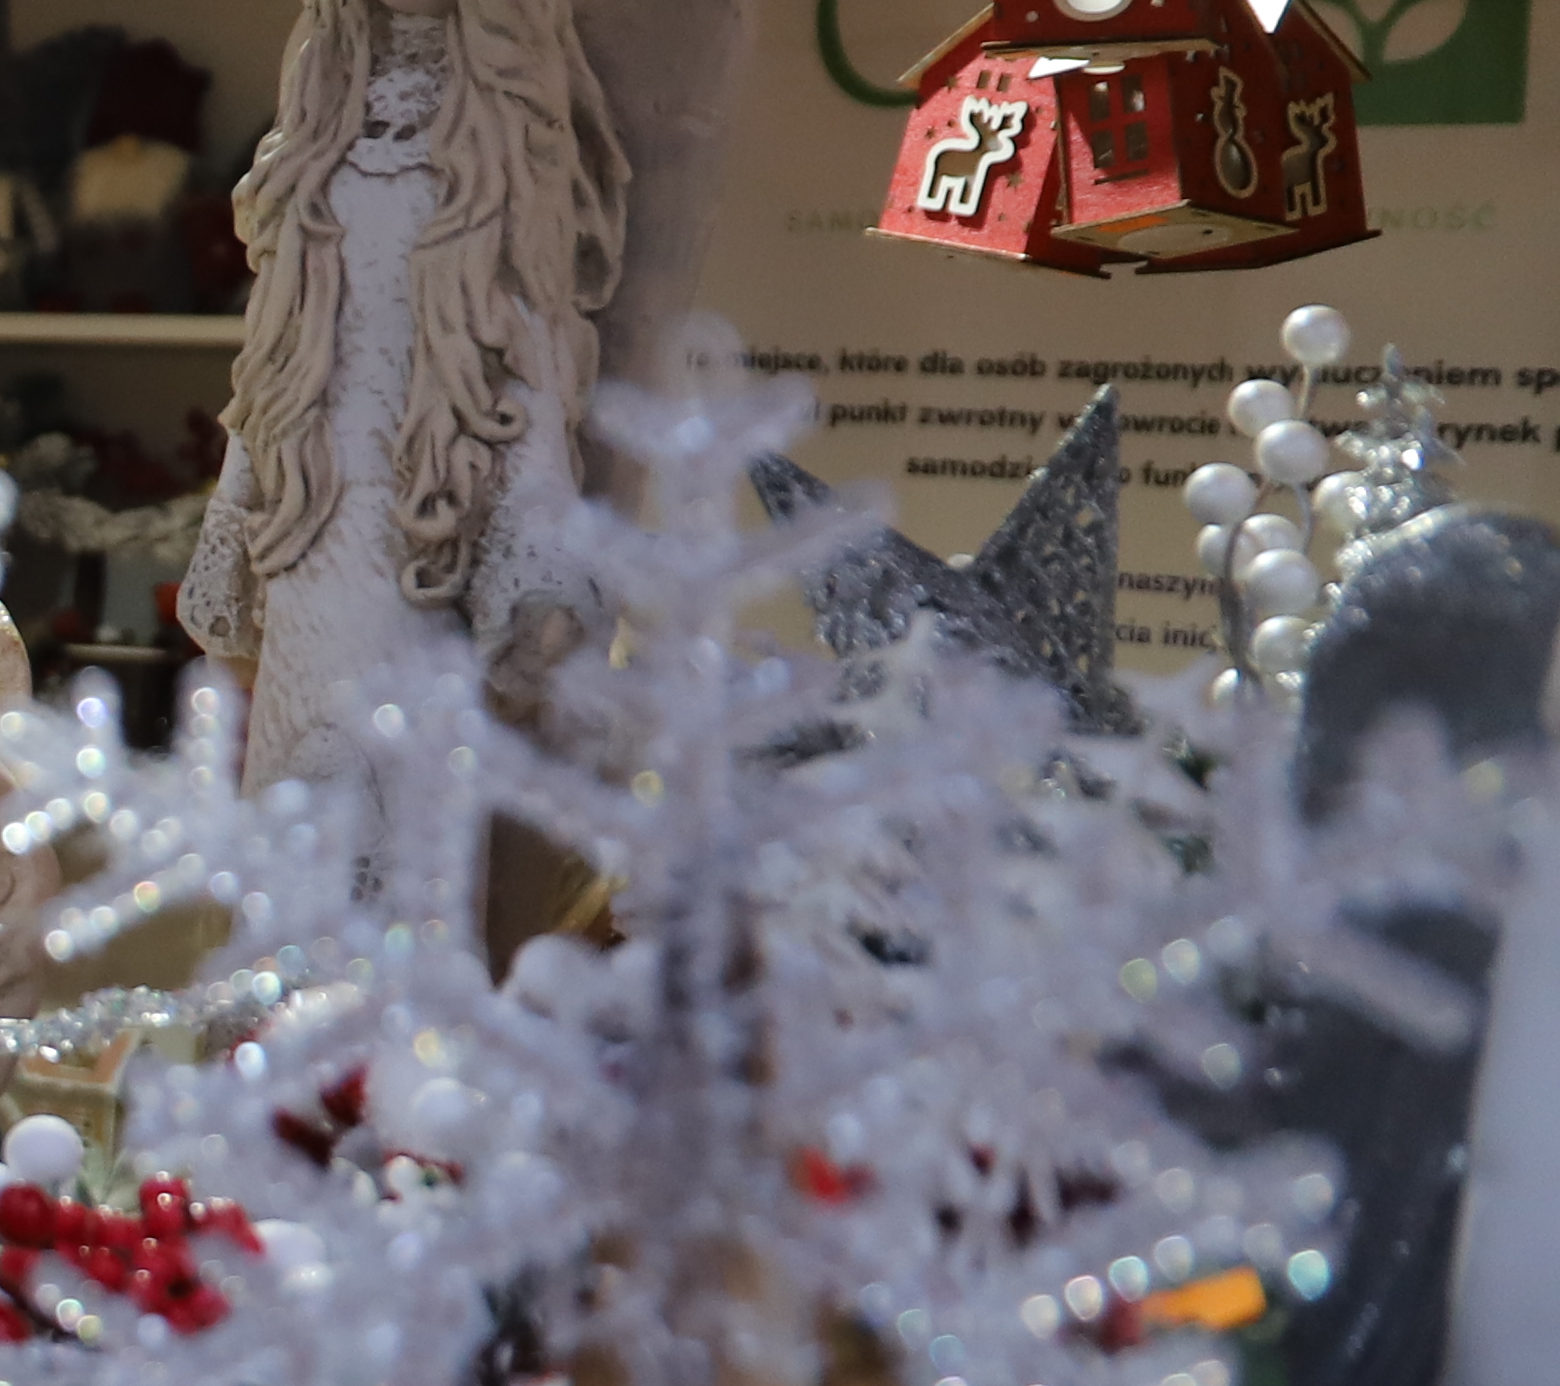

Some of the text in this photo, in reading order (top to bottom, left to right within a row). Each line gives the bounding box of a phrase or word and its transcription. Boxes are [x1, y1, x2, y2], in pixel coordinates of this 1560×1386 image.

[919, 348, 966, 375] dla
[976, 352, 1049, 377] osób
[828, 397, 909, 429] punkt
[918, 406, 1044, 437] zwrotny
[1437, 416, 1542, 450] rynek
